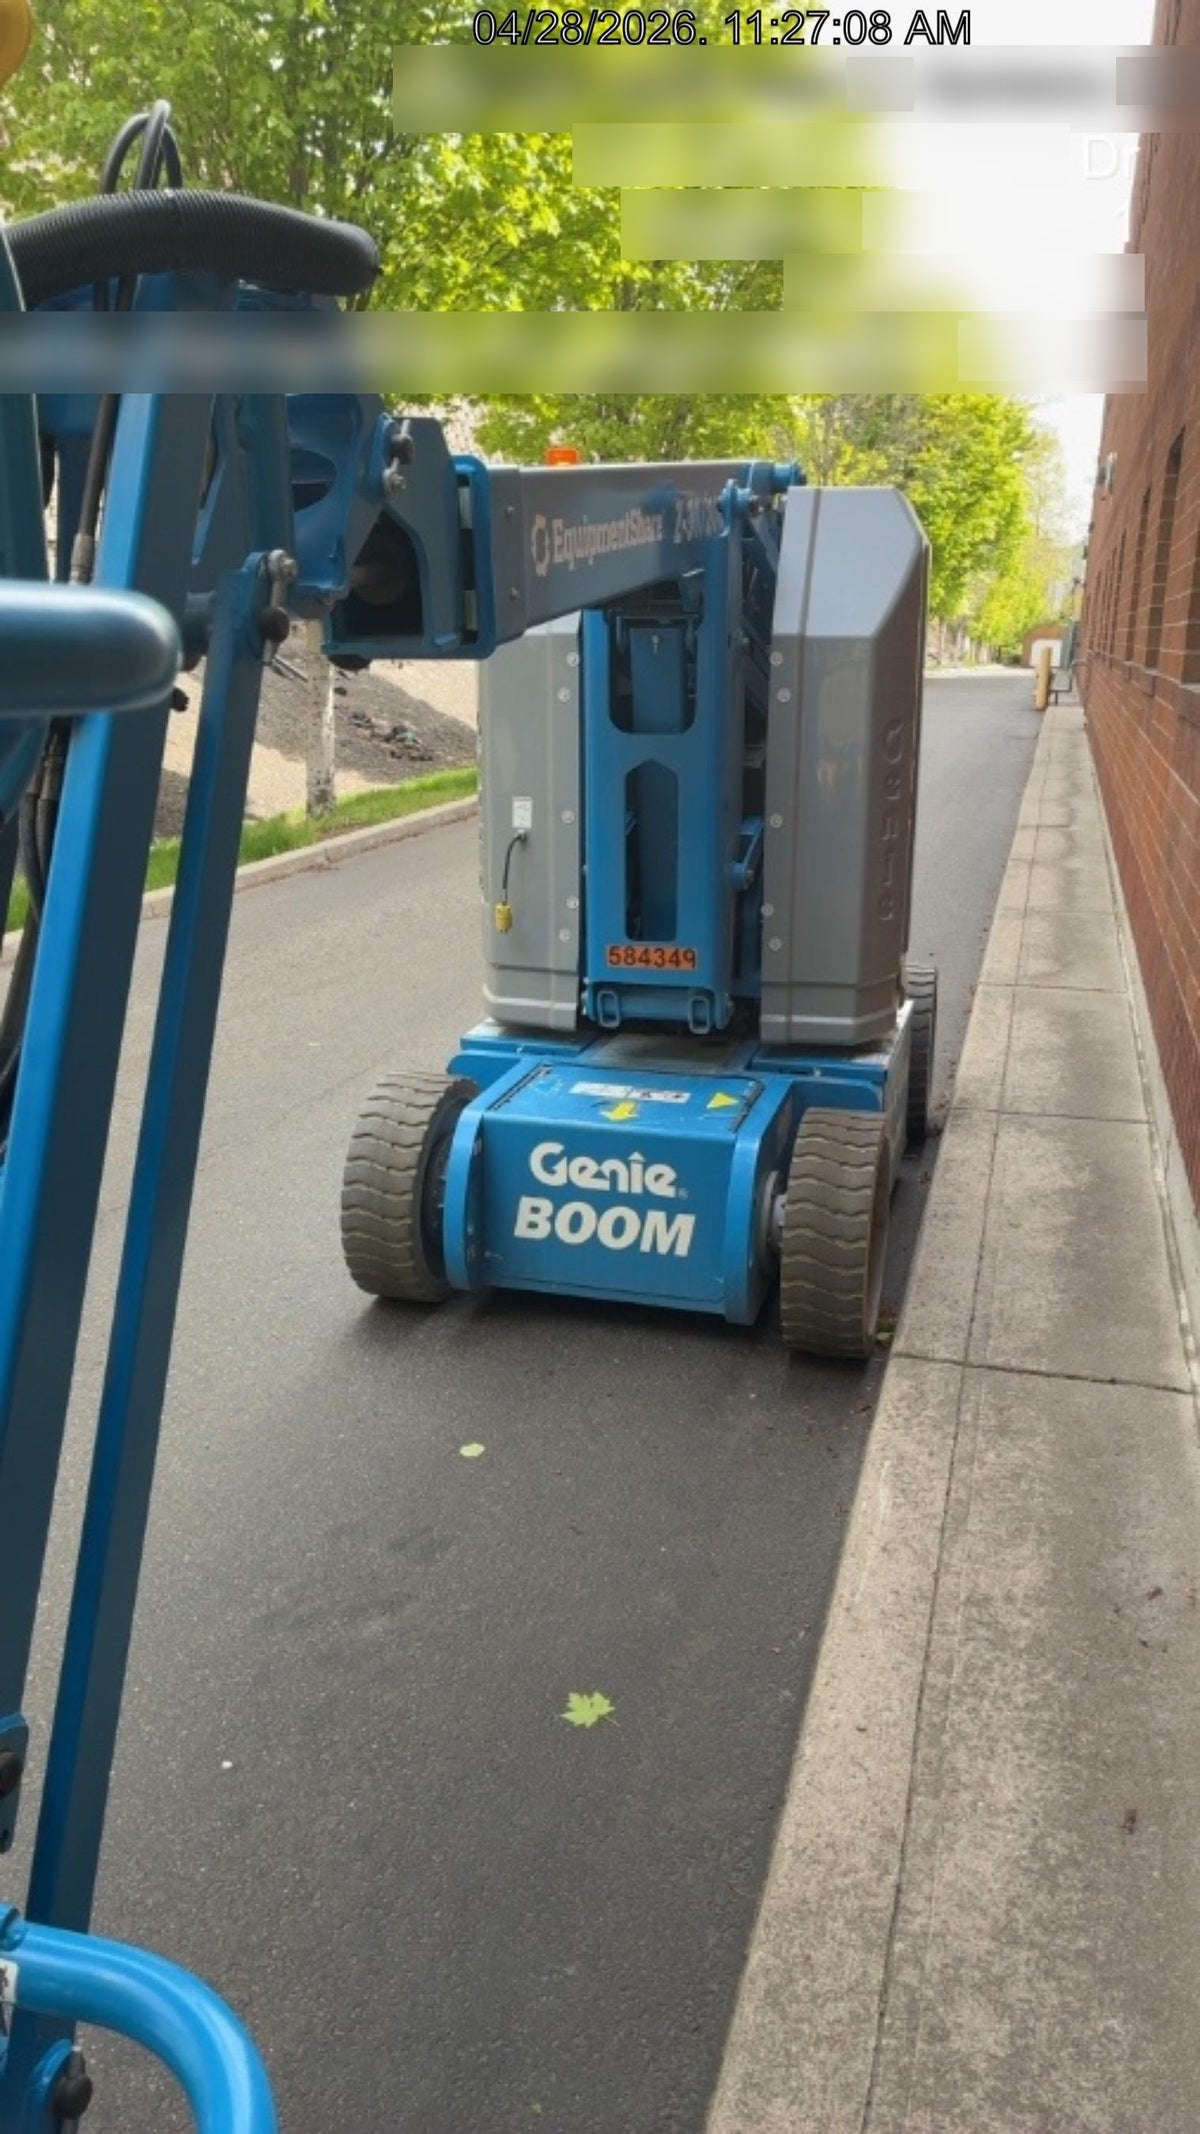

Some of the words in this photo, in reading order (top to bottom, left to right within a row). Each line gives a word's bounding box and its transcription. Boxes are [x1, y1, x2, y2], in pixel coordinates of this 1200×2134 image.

[608, 945, 696, 968] 584349
[529, 1141, 677, 1198] Genie
[513, 1195, 696, 1257] BOOM
